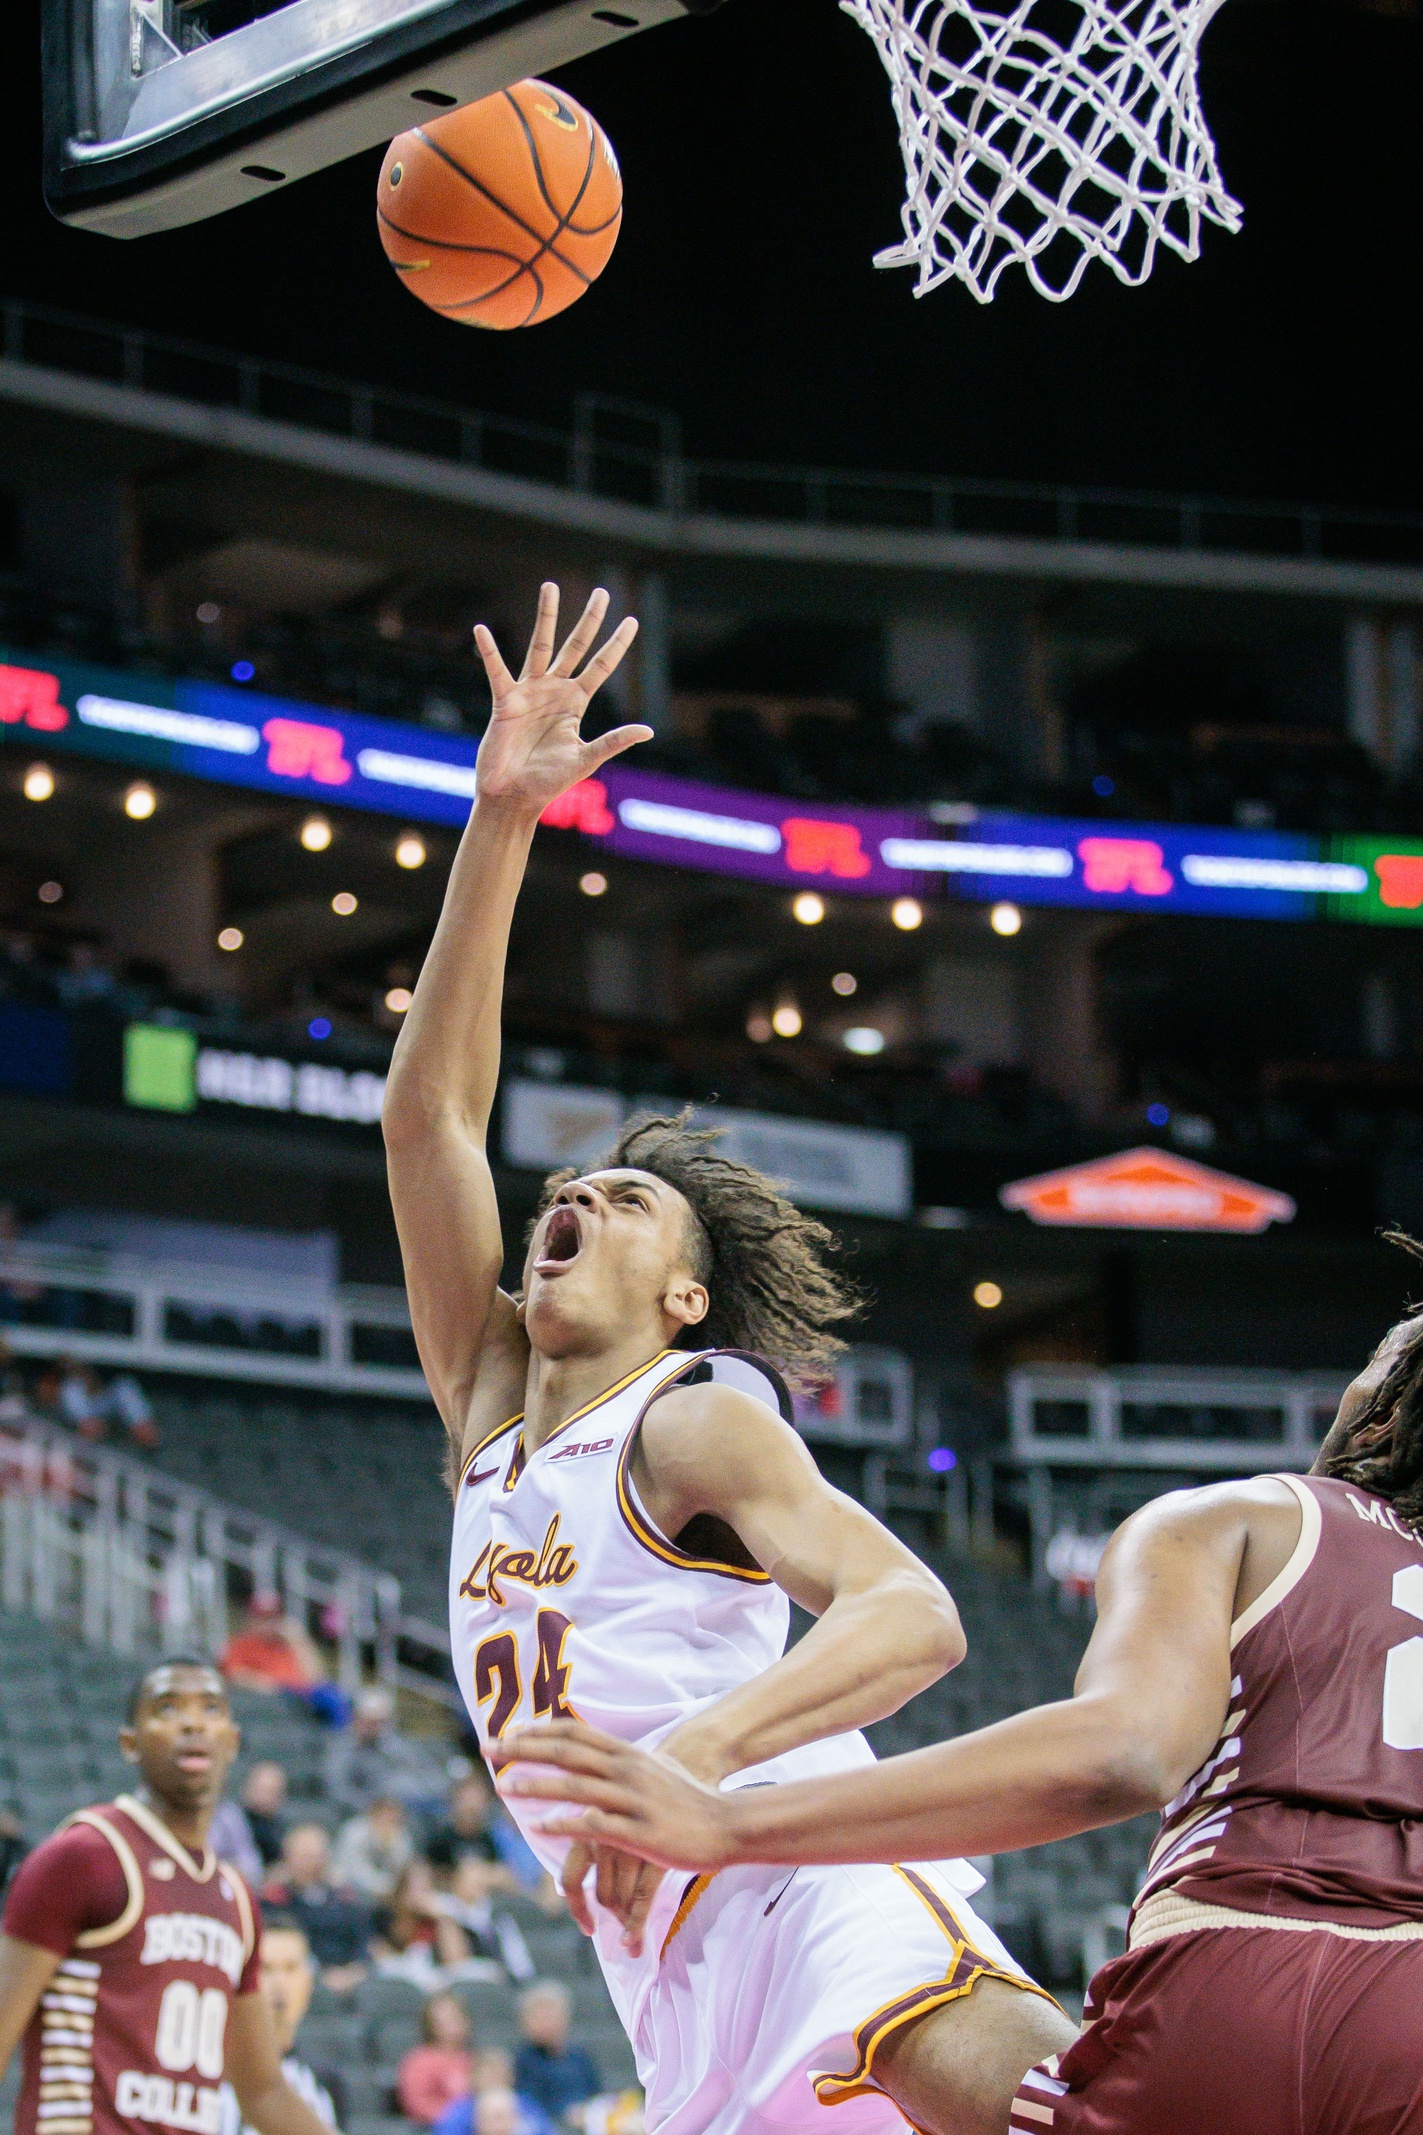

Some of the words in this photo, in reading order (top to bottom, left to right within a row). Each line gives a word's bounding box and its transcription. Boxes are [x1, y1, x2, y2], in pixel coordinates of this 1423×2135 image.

[1345, 1493, 1423, 1548] MC
[474, 1607, 588, 1778] 24
[155, 1979, 228, 2079] 00
